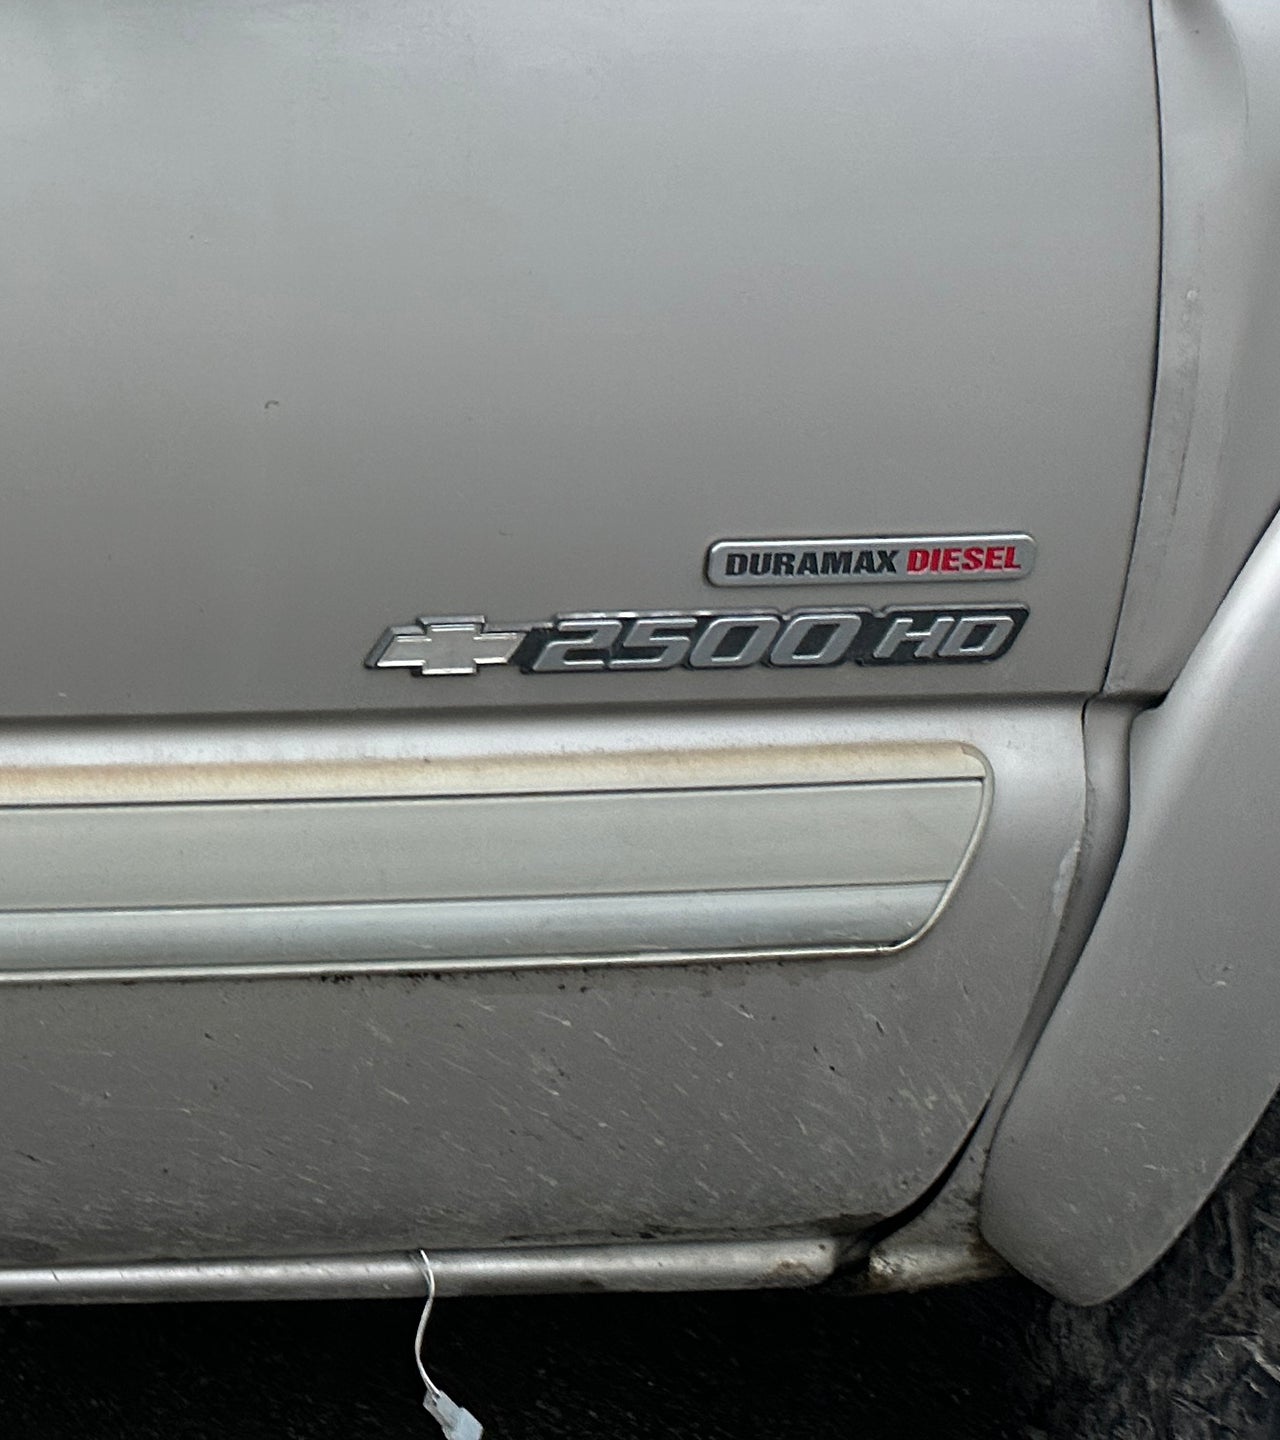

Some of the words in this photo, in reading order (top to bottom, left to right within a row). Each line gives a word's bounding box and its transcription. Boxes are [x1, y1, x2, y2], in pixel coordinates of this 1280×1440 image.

[724, 549, 899, 577] DURAMAX
[906, 545, 1023, 576] DIESEL
[532, 615, 863, 672] 2500
[870, 613, 1017, 661] HD
